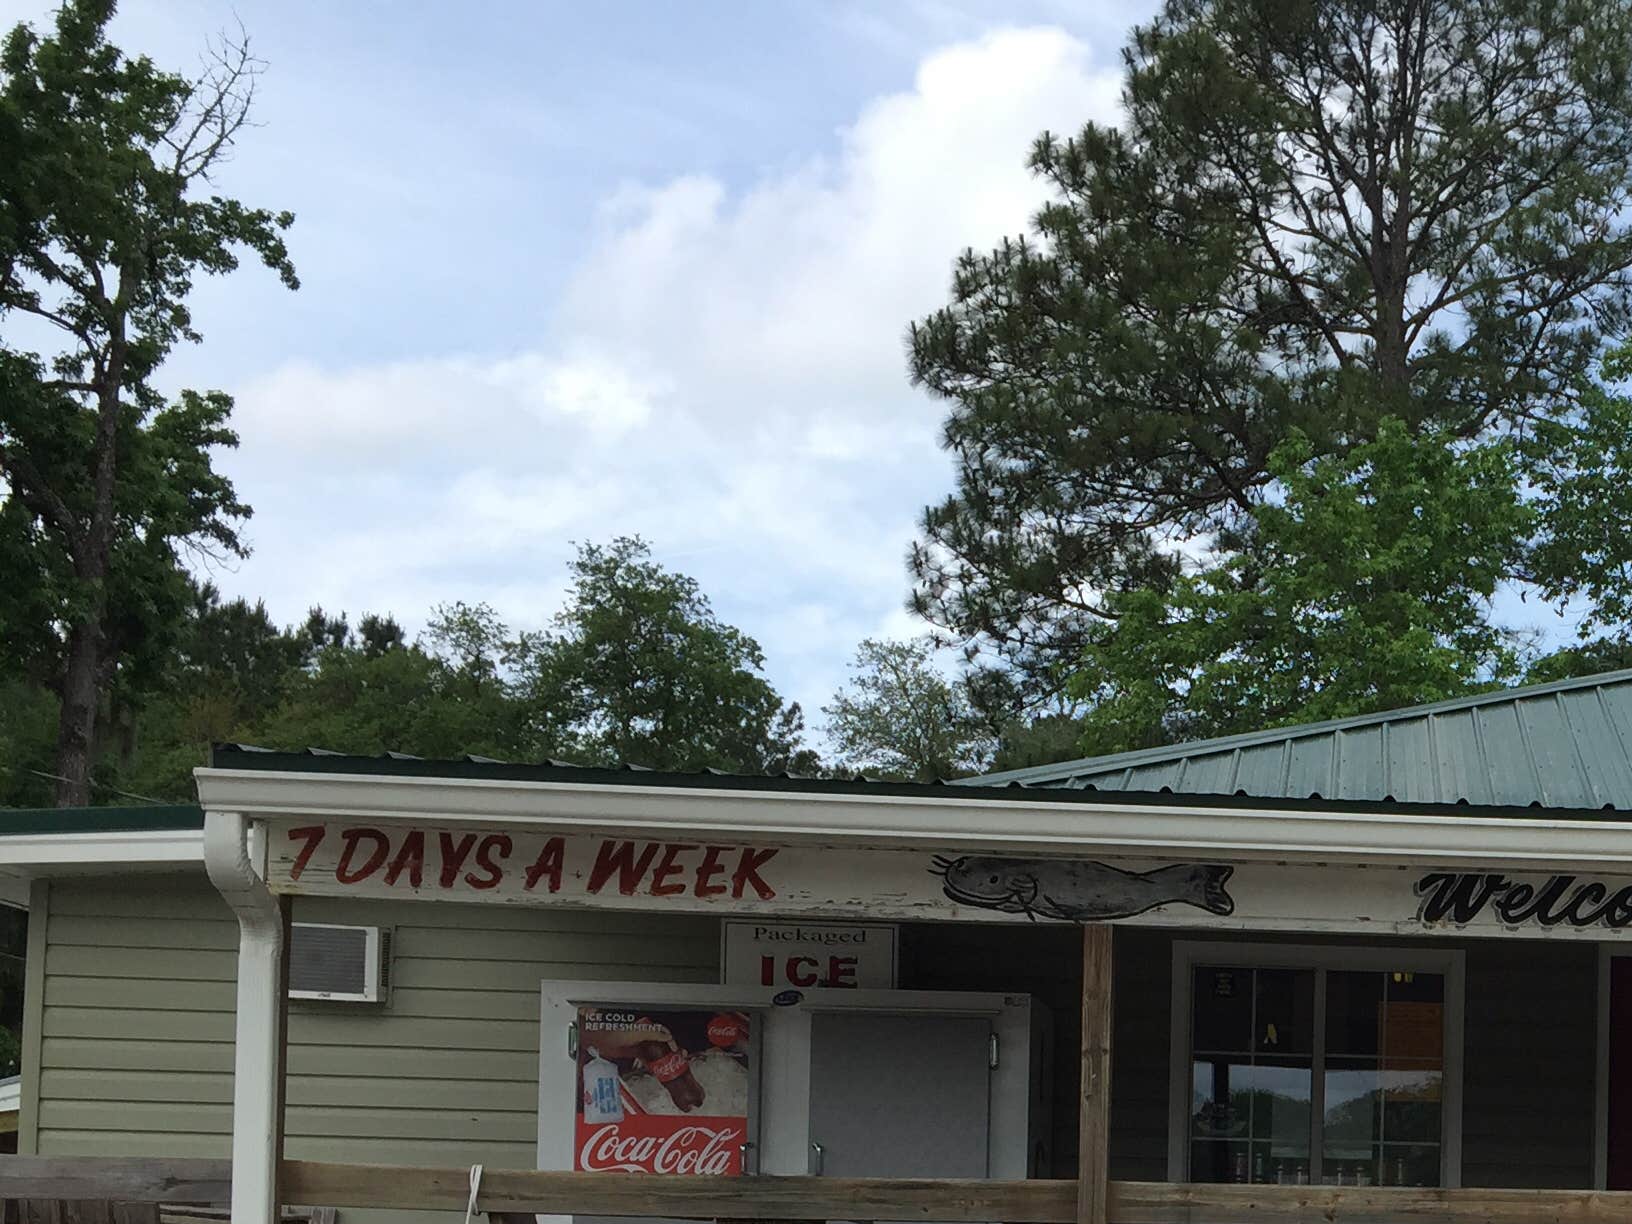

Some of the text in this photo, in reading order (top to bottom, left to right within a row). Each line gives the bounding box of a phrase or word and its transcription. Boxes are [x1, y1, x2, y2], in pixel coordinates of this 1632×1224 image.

[287, 826, 780, 899] 7 DAYS A WEEK
[752, 926, 867, 988] Packaged ICE
[585, 1013, 635, 1022] ICE COLD
[585, 1022, 663, 1032] REFRESHMENT
[580, 1124, 742, 1175] Coca-Cola
